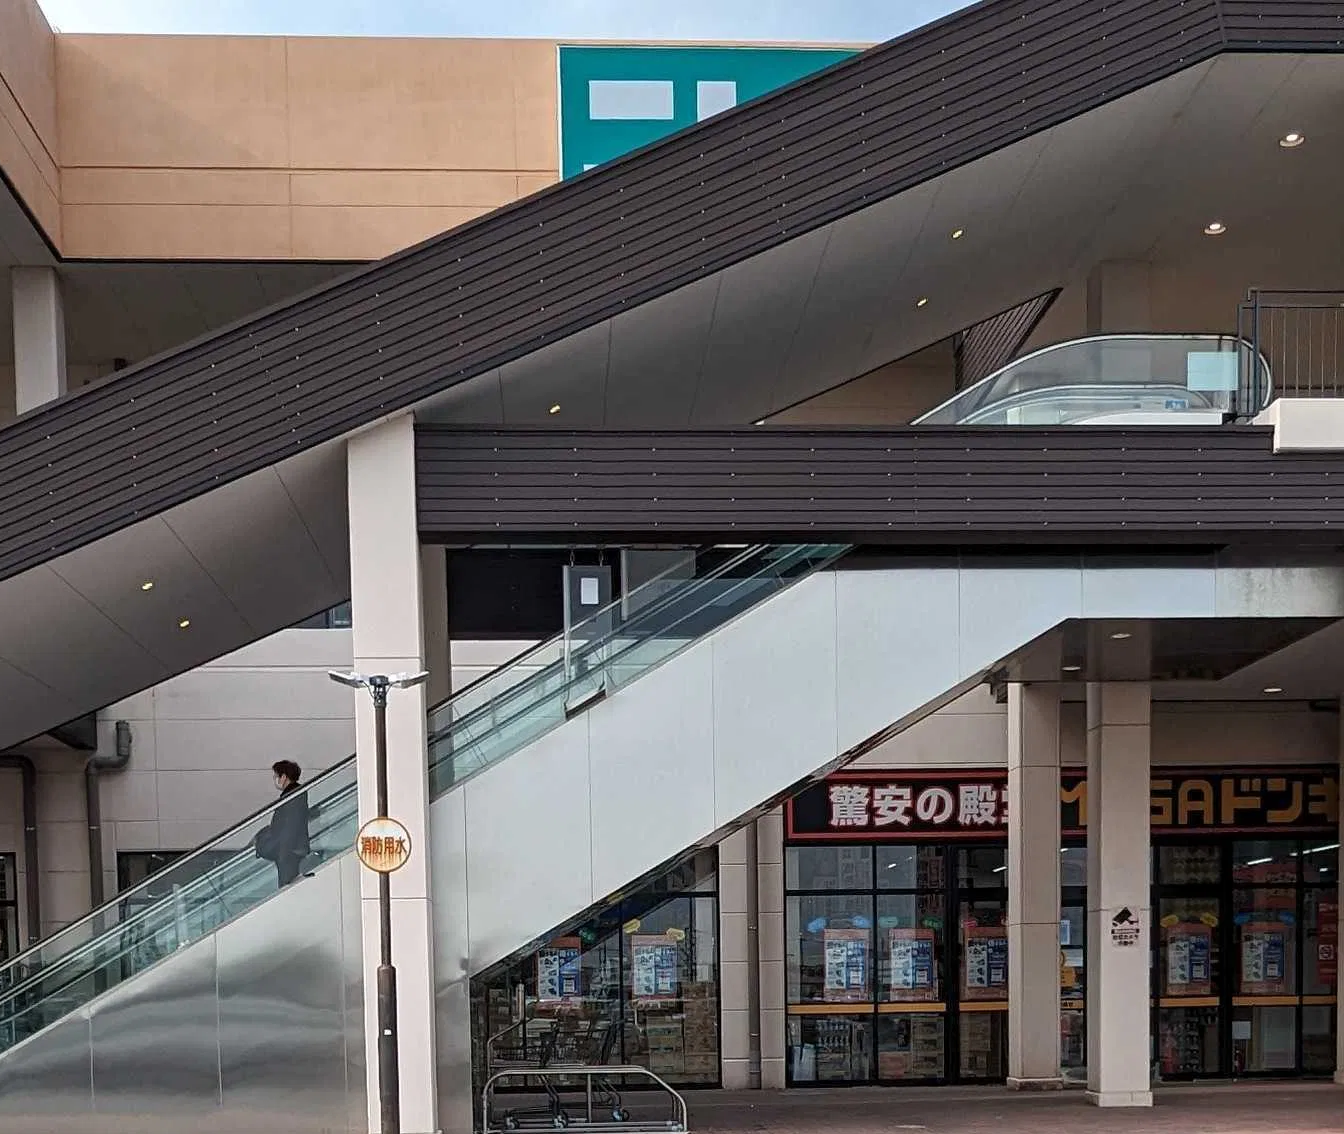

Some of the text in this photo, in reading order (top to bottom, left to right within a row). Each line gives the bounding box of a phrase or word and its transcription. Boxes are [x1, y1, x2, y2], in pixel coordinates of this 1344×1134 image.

[829, 783, 1009, 827] 驚安の殿
[361, 836, 408, 856] 消防用水
